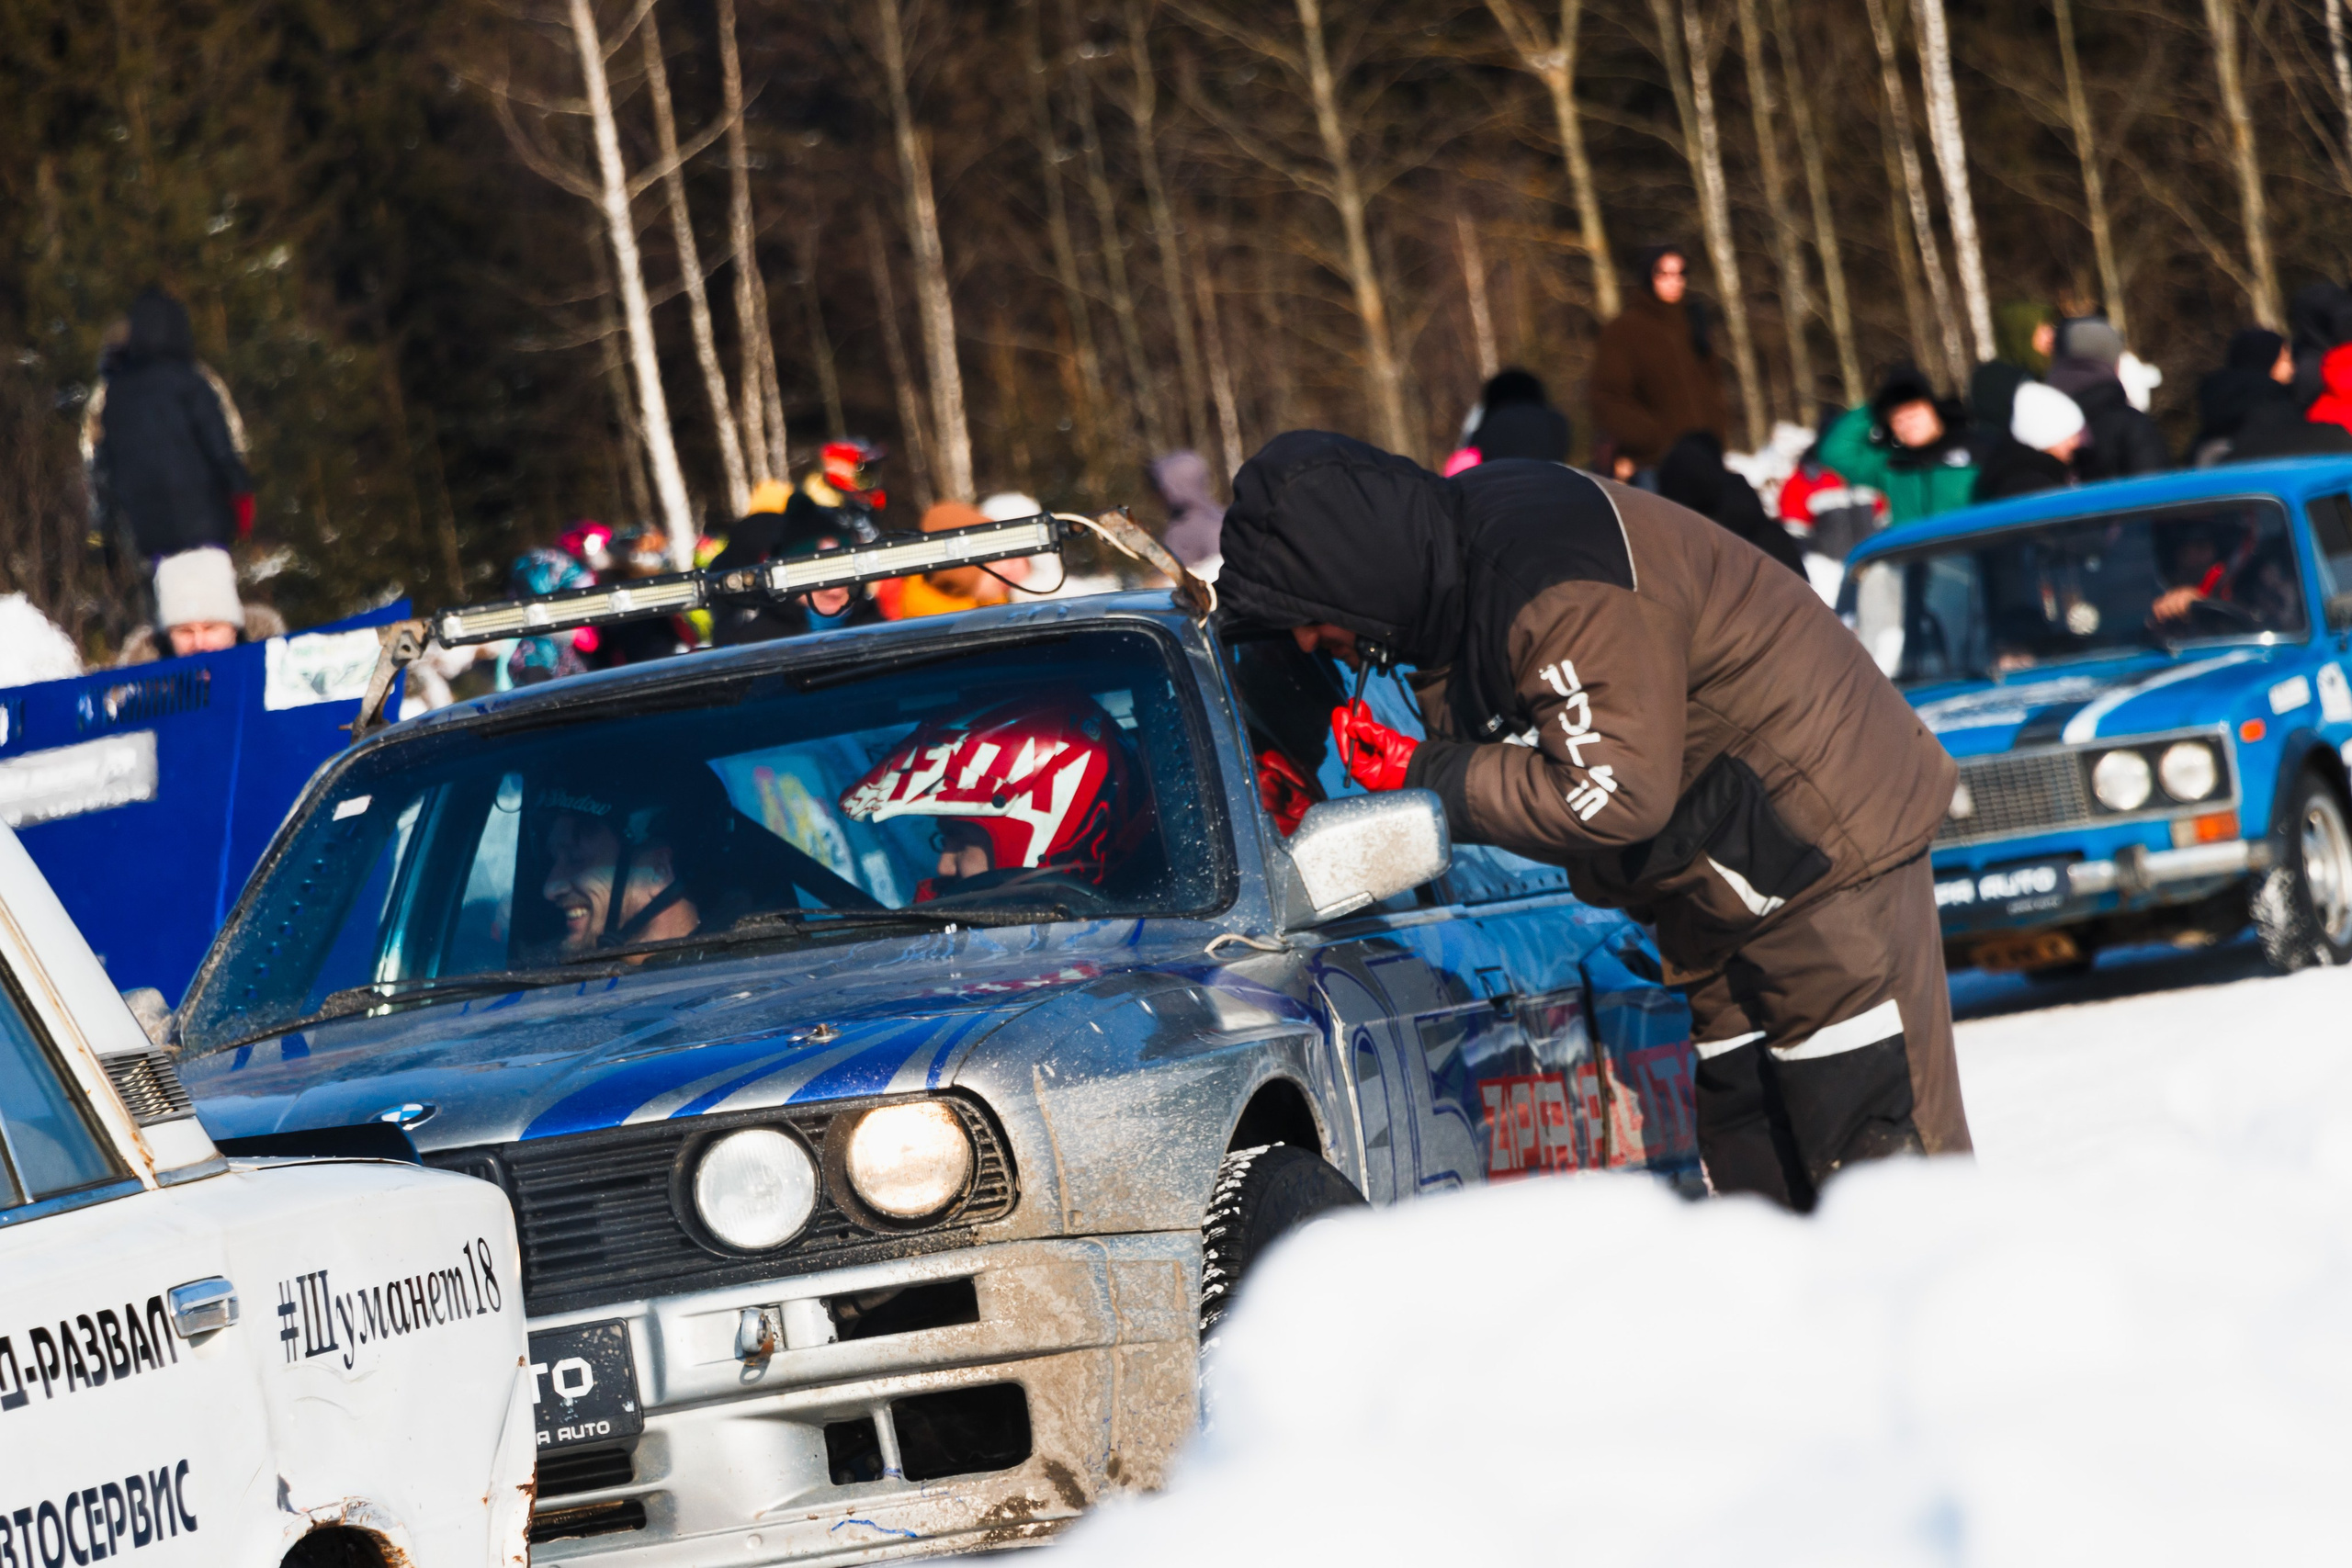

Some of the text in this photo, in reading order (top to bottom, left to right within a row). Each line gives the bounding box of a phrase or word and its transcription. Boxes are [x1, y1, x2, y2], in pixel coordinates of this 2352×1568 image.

[1978, 866, 2057, 901] AUTO
[1481, 1047, 1697, 1172] ZIPA AUT
[0, 1294, 179, 1413] Д-РАЗВАЛ
[277, 1236, 502, 1371] #Шуманет18
[557, 1420, 611, 1442] AUTO
[0, 1459, 198, 1568] ВТОСЕРВИС
